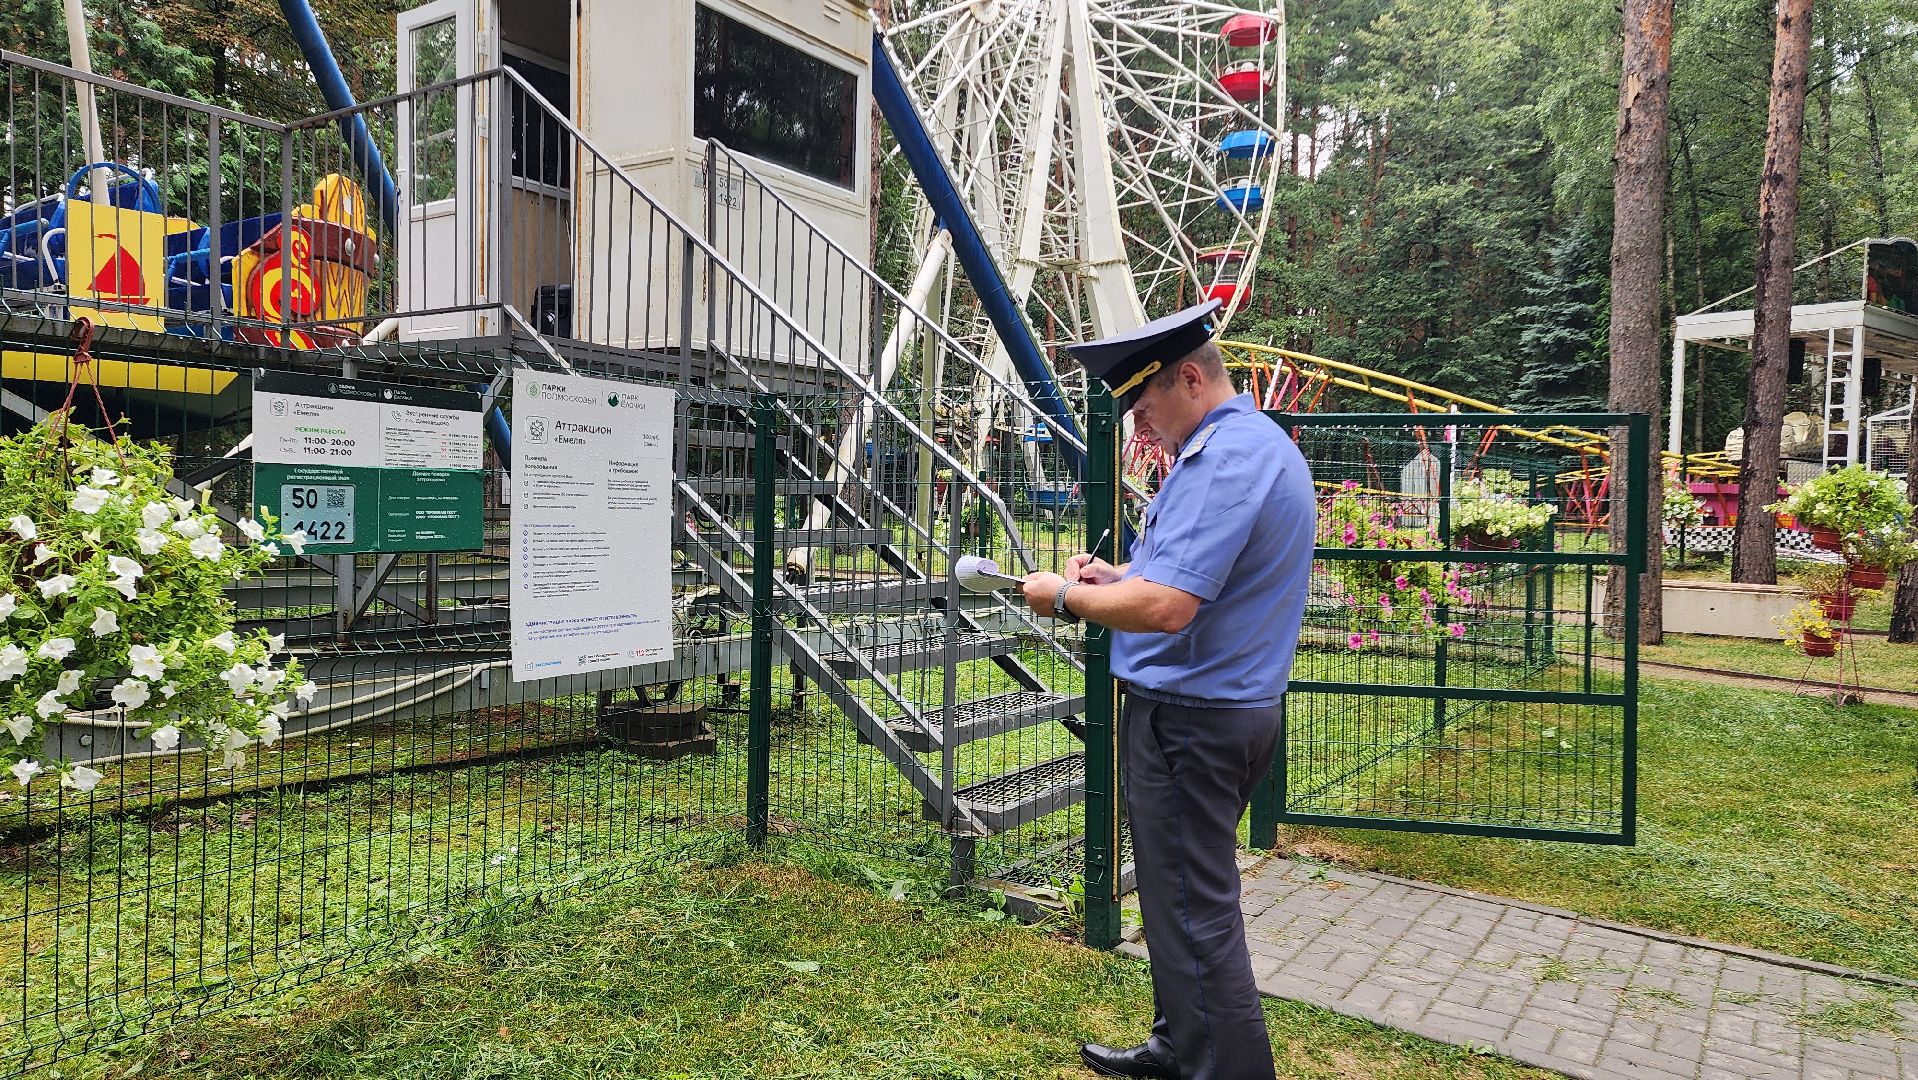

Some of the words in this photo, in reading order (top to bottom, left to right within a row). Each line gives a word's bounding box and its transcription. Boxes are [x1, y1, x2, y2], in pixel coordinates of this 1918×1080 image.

[541, 383, 566, 392] ПАРКИ
[541, 391, 597, 406] ПОДМОСКОВЬЯ
[621, 393, 639, 401] ПАРК
[294, 401, 334, 411] Аттракцион
[620, 400, 646, 411] ЁЛОЧКИ
[294, 426, 319, 434] РЕЖИМ
[320, 427, 346, 435] РАБОТЫ
[554, 420, 612, 435] Аттракцион
[554, 434, 586, 446] «Емеля»
[291, 487, 318, 509] 50
